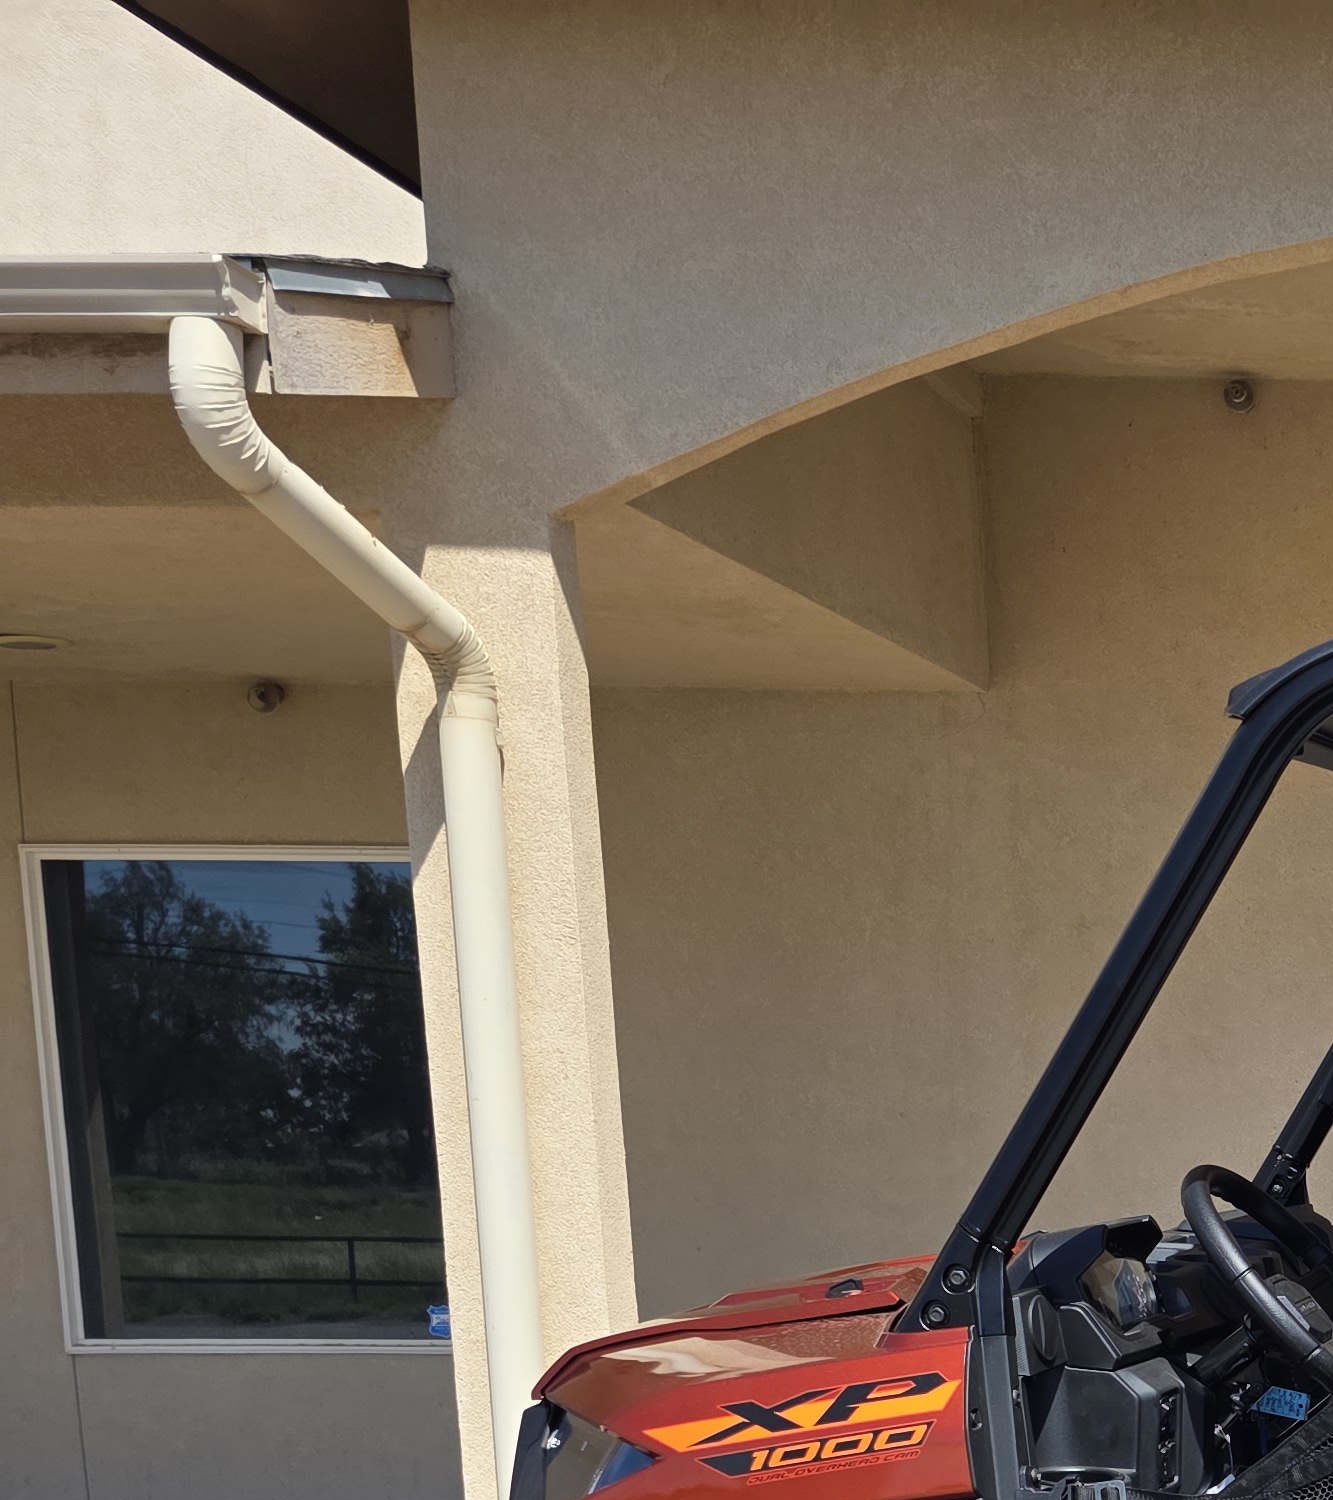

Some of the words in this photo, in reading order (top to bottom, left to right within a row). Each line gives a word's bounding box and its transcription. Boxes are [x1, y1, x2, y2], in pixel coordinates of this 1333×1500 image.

[686, 1370, 949, 1448] XP
[747, 1471, 791, 1484] DUAL
[794, 1455, 881, 1477] OVERHEAD
[884, 1449, 920, 1462] CAM
[750, 1424, 929, 1471] 1000
